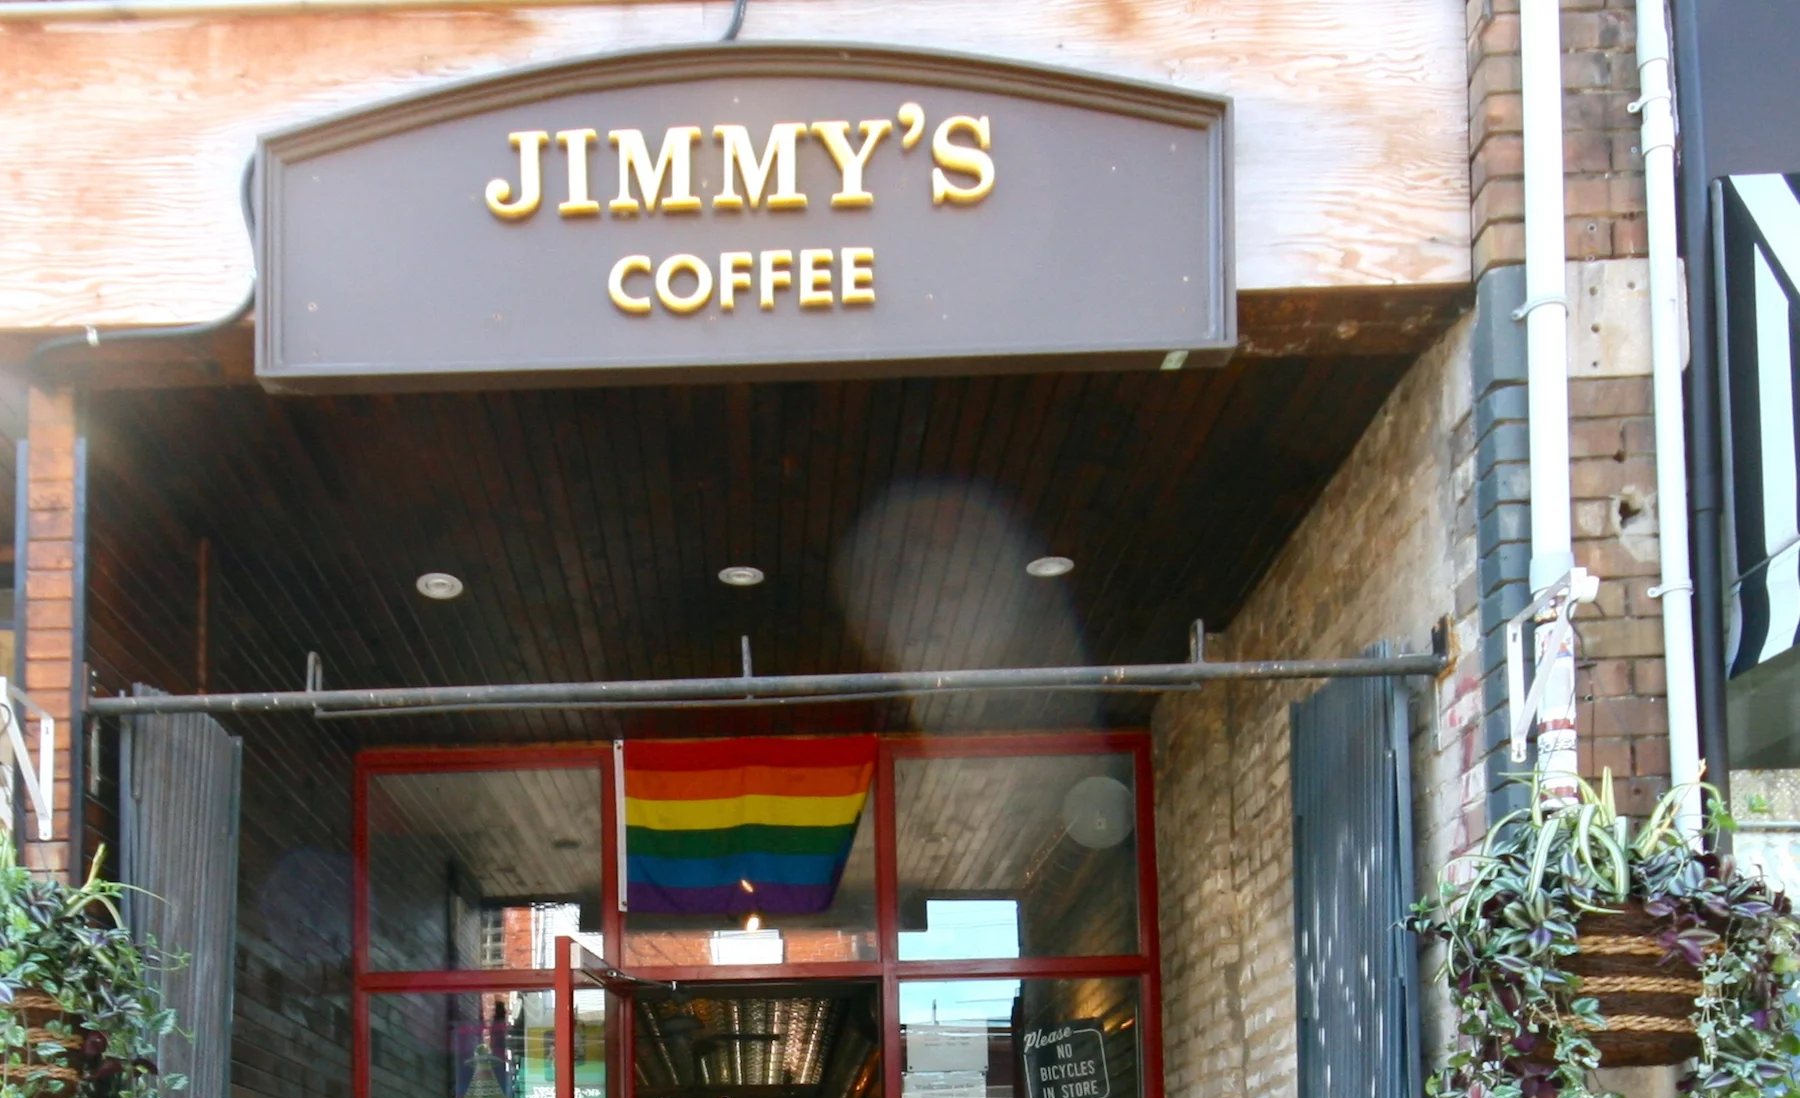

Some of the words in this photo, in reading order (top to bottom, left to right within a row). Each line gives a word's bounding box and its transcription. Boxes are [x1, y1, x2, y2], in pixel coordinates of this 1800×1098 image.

[485, 102, 996, 220] JIMMY'S
[607, 246, 876, 314] COFFEE
[1024, 1027, 1073, 1053] Please
[1056, 1043, 1073, 1060] NO
[1040, 1060, 1096, 1082] BICYCLES
[1061, 1080, 1099, 1098] STORE
